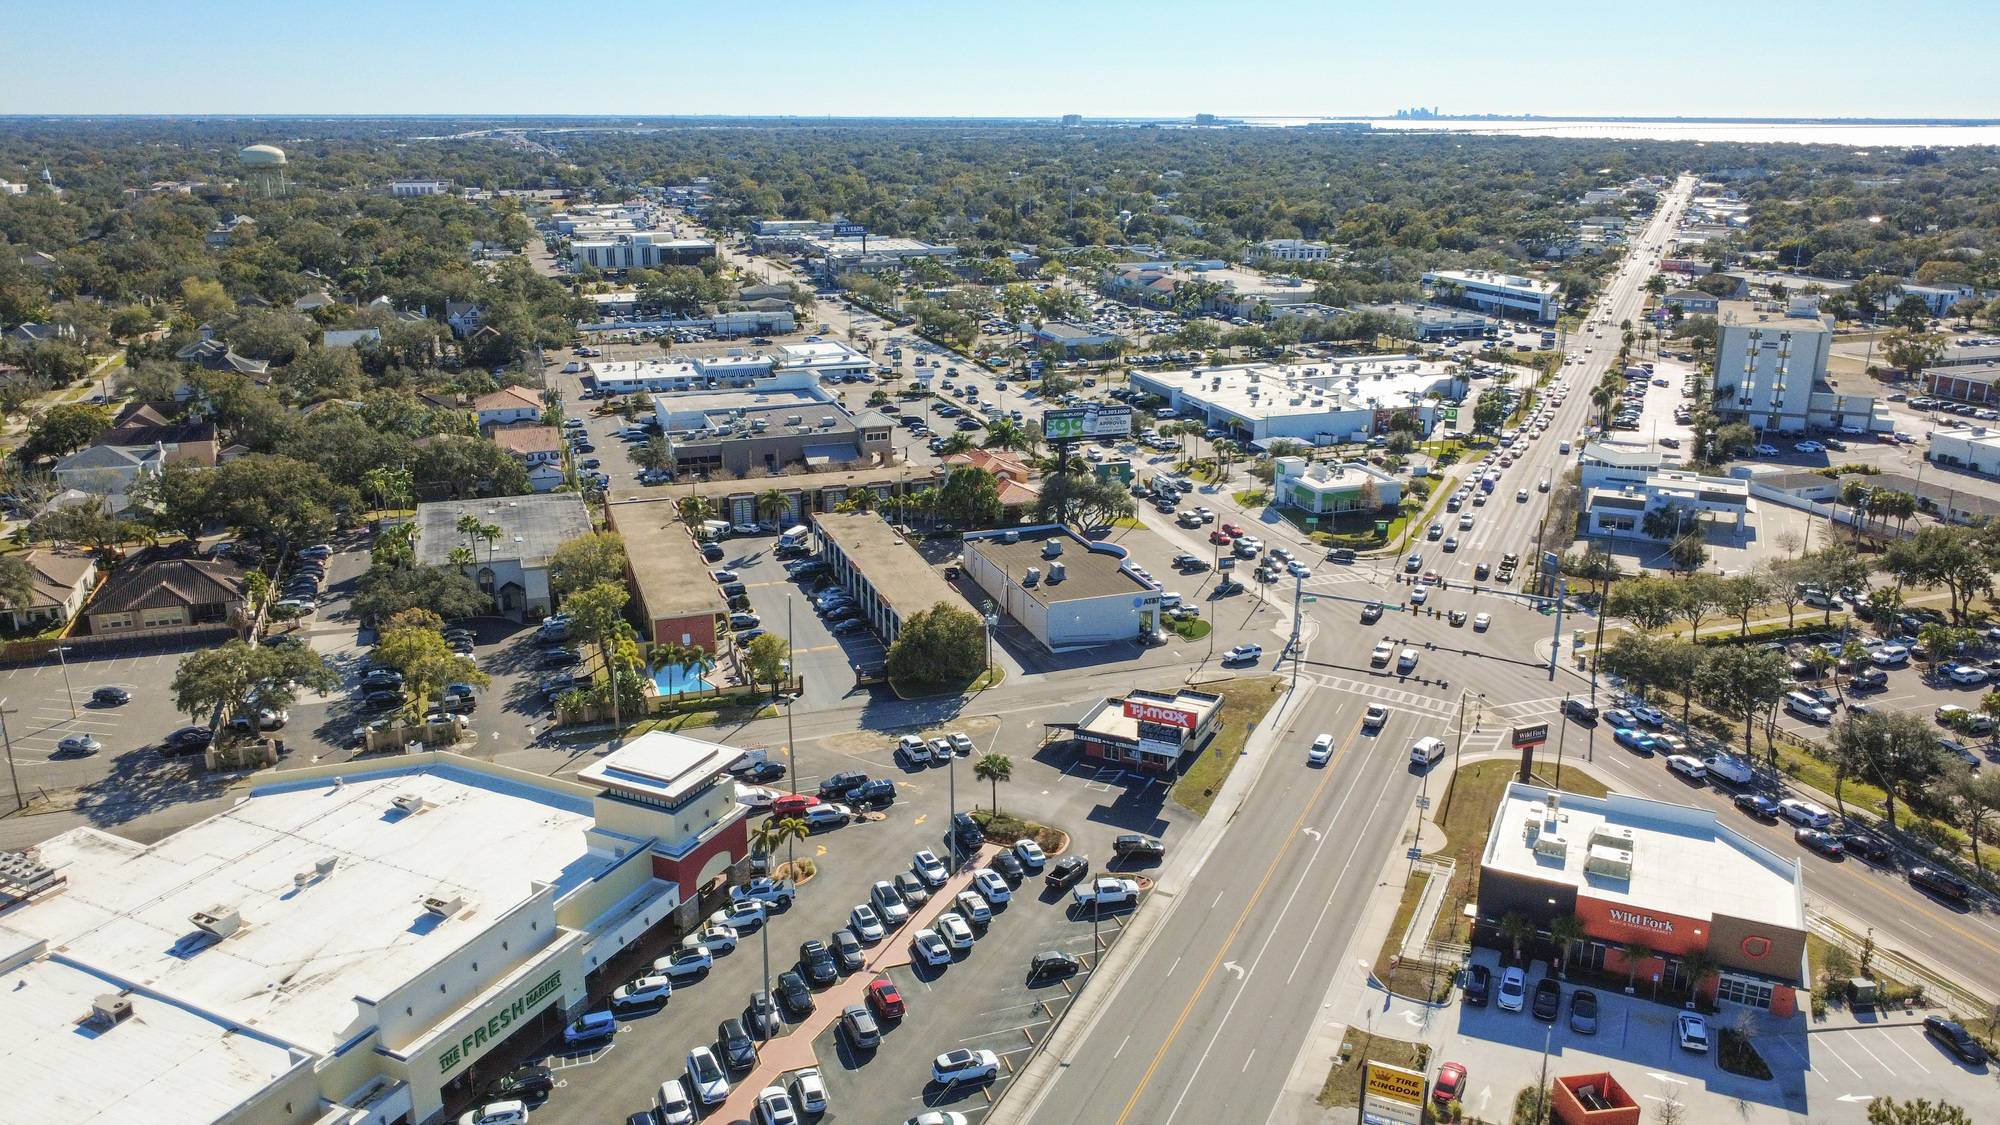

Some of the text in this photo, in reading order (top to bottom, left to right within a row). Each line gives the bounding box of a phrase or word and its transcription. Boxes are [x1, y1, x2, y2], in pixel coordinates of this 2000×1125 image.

[1074, 733, 1101, 744] CLEANERS
[1519, 731, 1532, 739] Wild
[1609, 908, 1673, 931] Wild Fork
[439, 974, 562, 1069] THE FRESH MARKET
[1369, 1079, 1420, 1097] KINGDOM
[1395, 1077, 1420, 1088] TIRE
